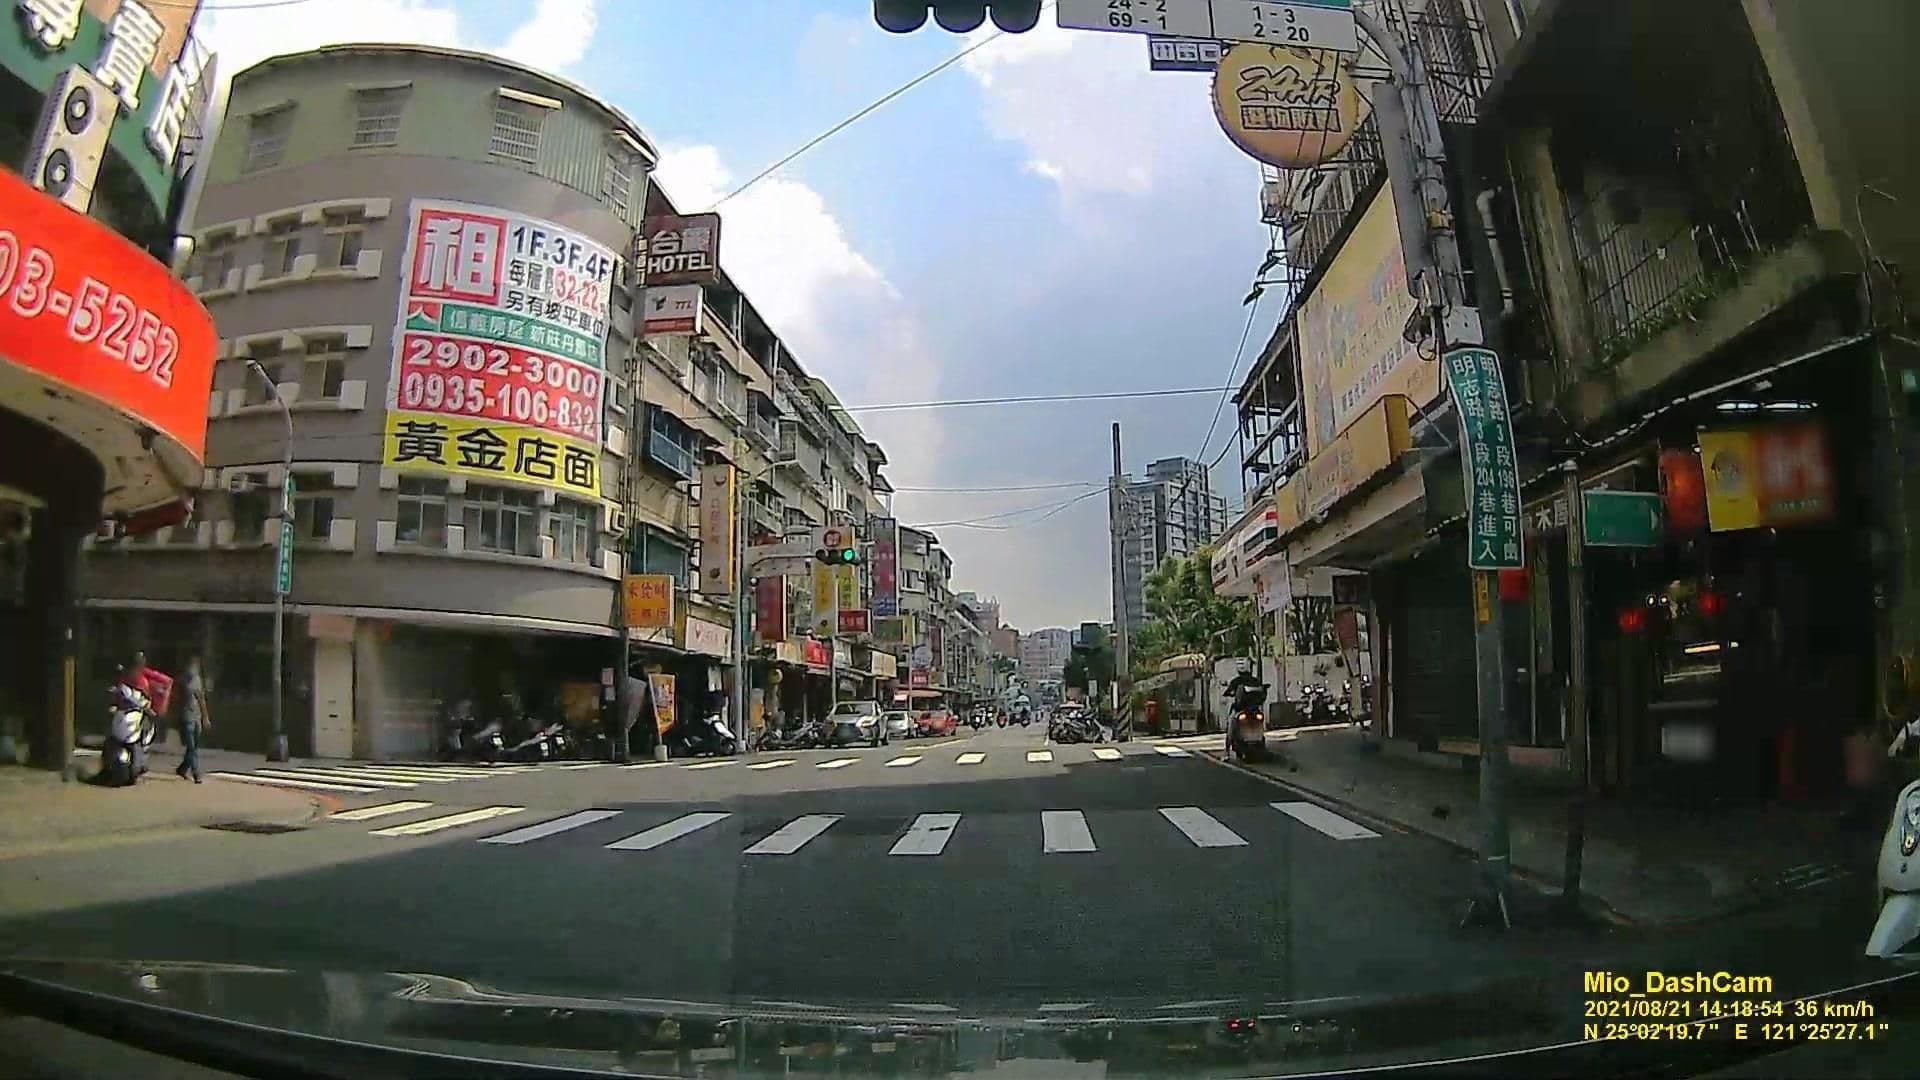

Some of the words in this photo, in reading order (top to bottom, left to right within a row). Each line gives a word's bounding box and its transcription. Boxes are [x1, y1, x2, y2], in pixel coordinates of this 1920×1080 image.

[1109, 11, 1133, 28] 69
[1254, 22, 1265, 38] 2
[1286, 26, 1309, 42] 20
[1284, 8, 1296, 23] 3
[420, 217, 502, 296] 租
[513, 226, 609, 279] 1F.3F.4F
[647, 253, 713, 275] HOTEL
[652, 227, 711, 255] 台
[407, 339, 599, 399] 2902-3000
[405, 371, 596, 438] 0935-106-832
[394, 420, 595, 489] 黃金店面
[1452, 355, 1496, 561] 明志路3段204巷進入
